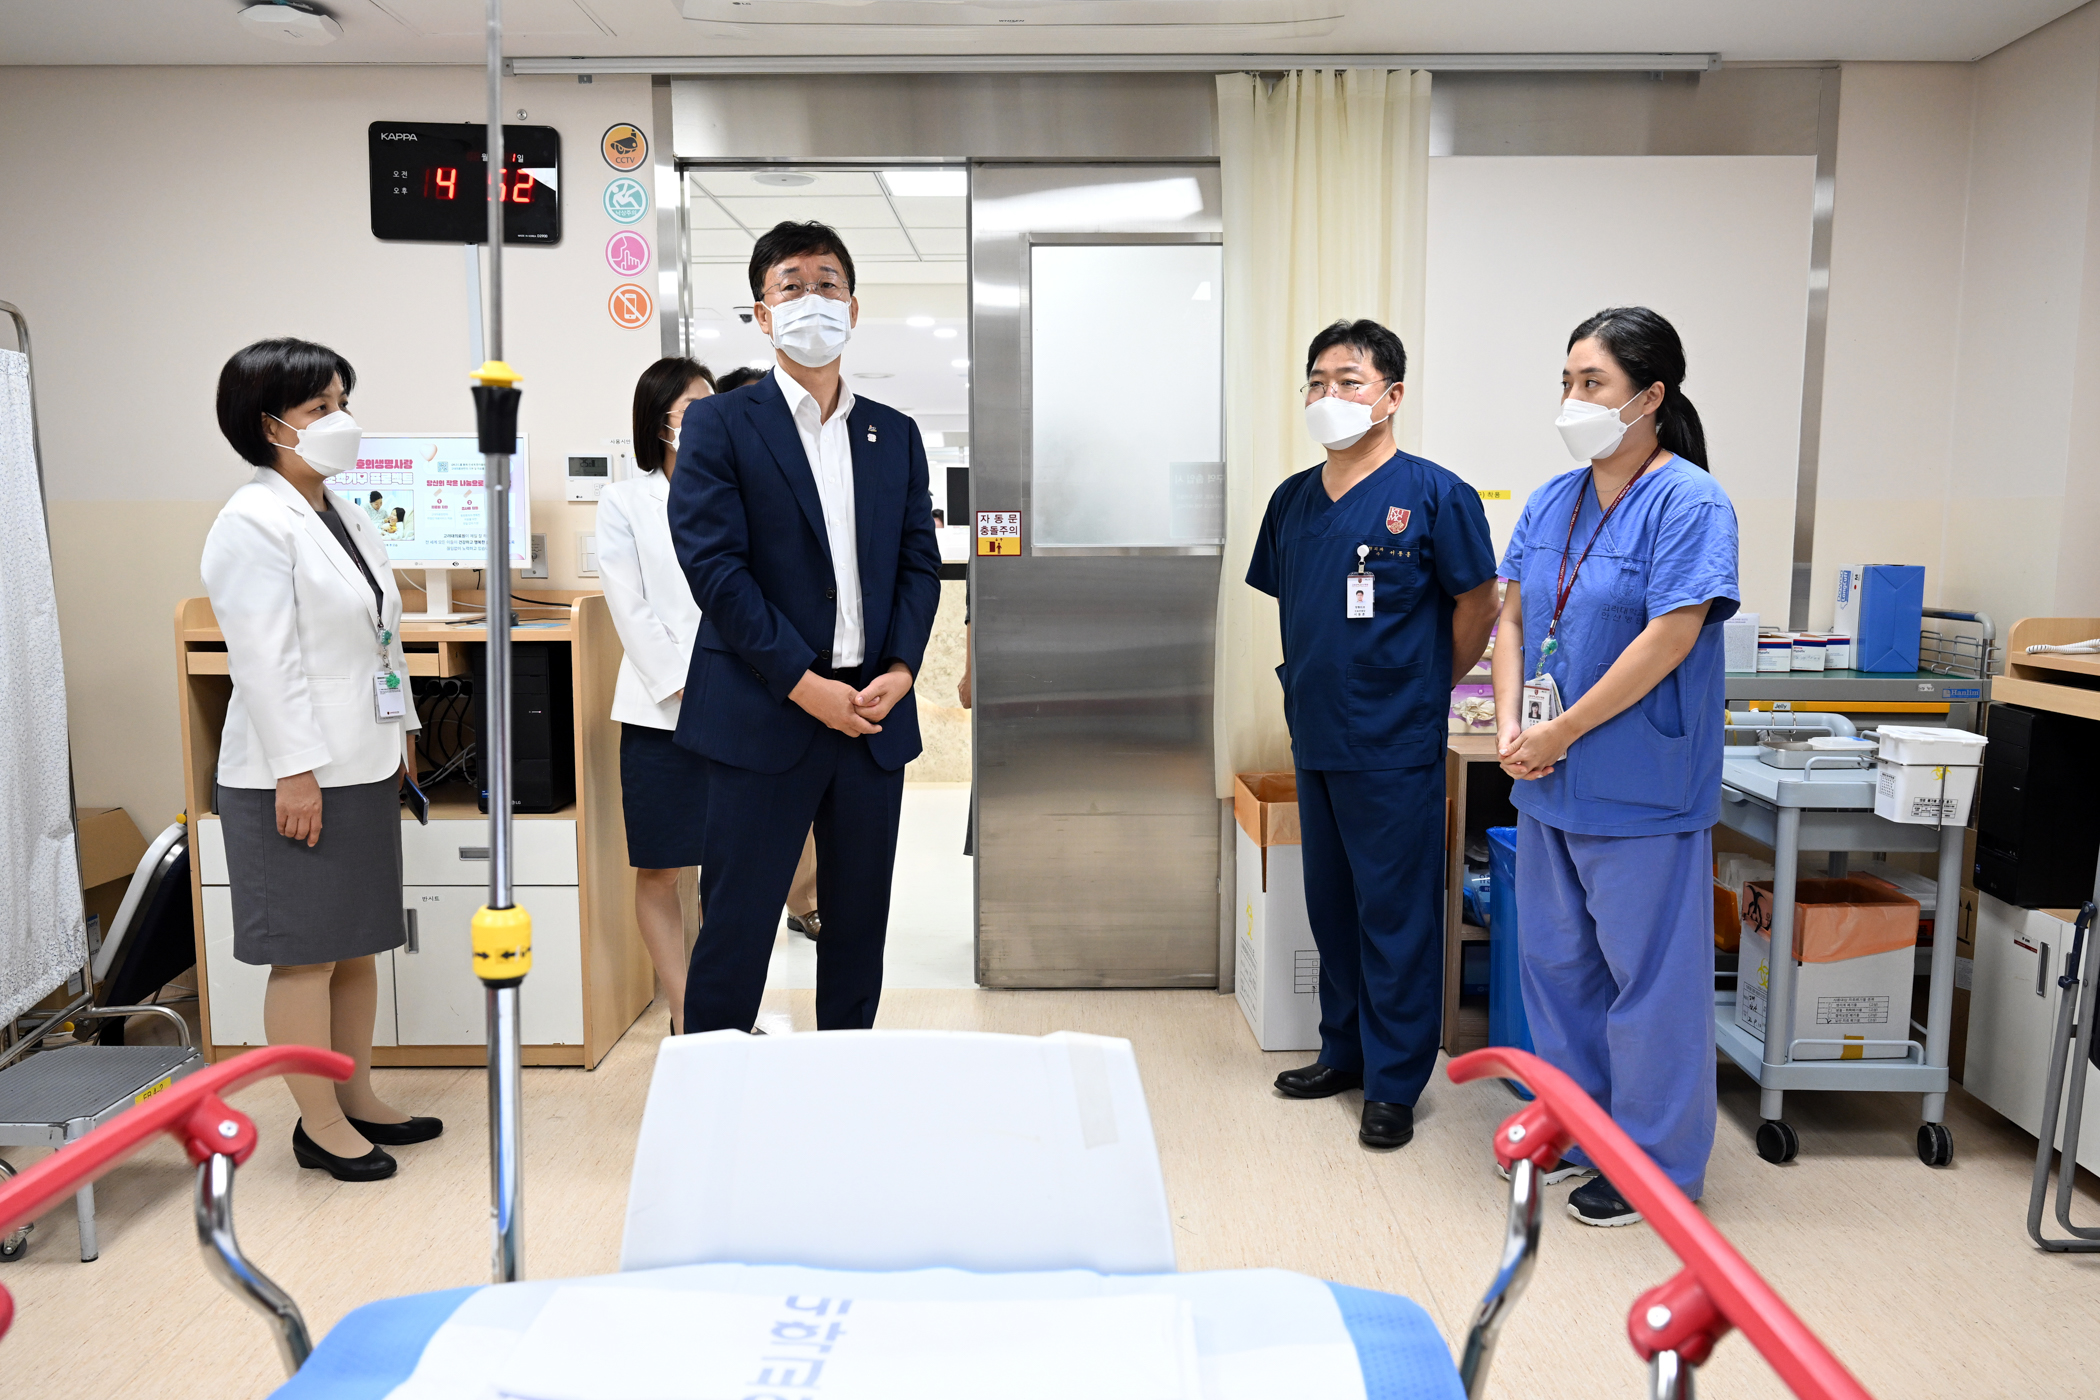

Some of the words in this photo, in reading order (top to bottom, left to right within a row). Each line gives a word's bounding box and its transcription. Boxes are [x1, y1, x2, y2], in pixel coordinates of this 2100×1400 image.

[381, 133, 418, 141] KAPPA
[393, 187, 408, 195] 오후
[980, 525, 1018, 535] 충돌주의
[1602, 603, 1644, 617] 고려대학교
